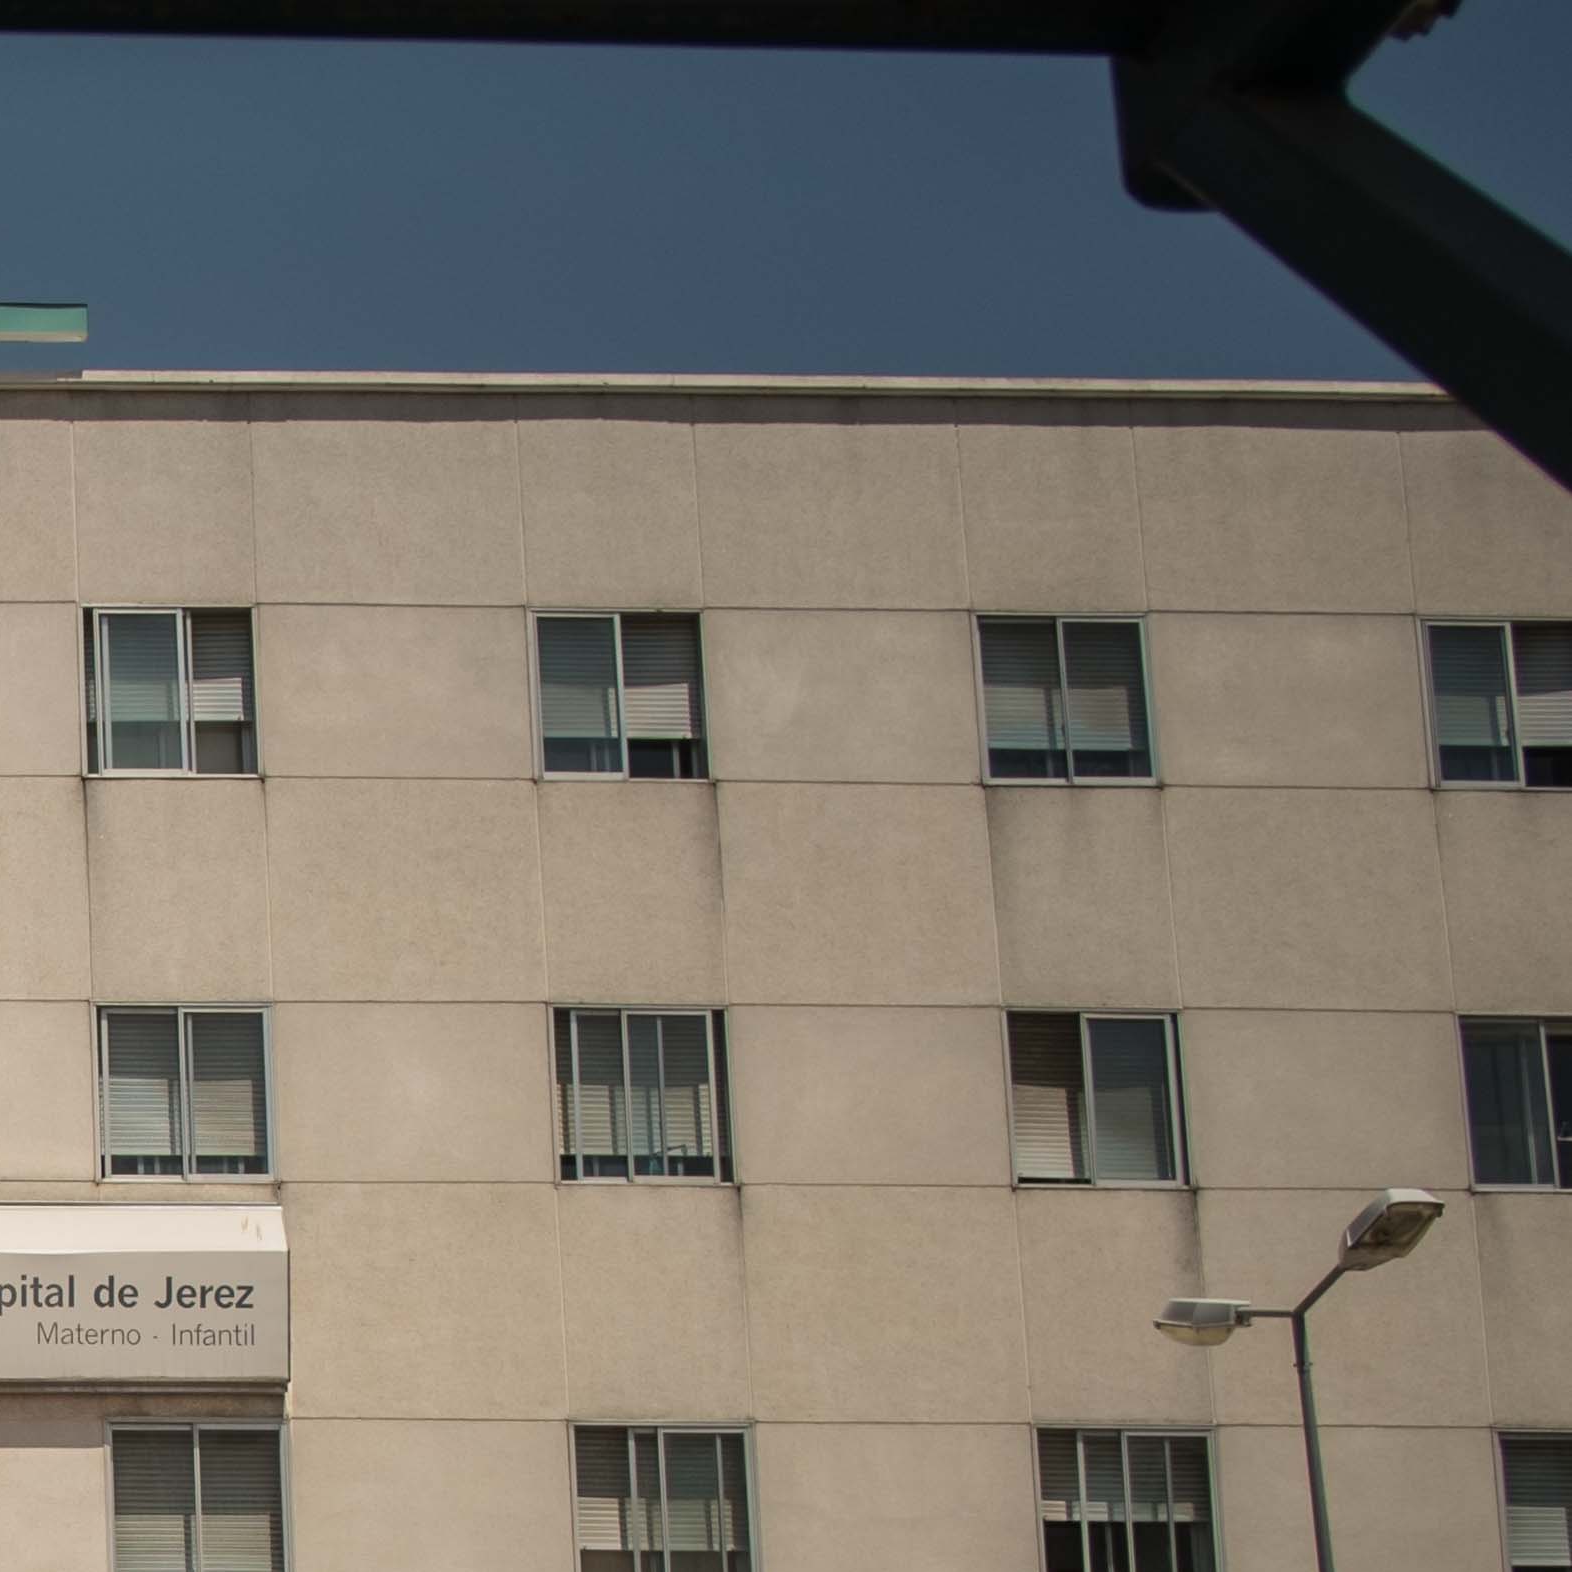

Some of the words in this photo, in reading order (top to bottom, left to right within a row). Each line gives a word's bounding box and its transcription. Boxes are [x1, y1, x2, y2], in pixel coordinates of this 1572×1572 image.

[93, 1275, 138, 1308] de
[154, 1276, 254, 1309] Jerez
[36, 1321, 141, 1346] Materno
[171, 1323, 255, 1347] Infantil
